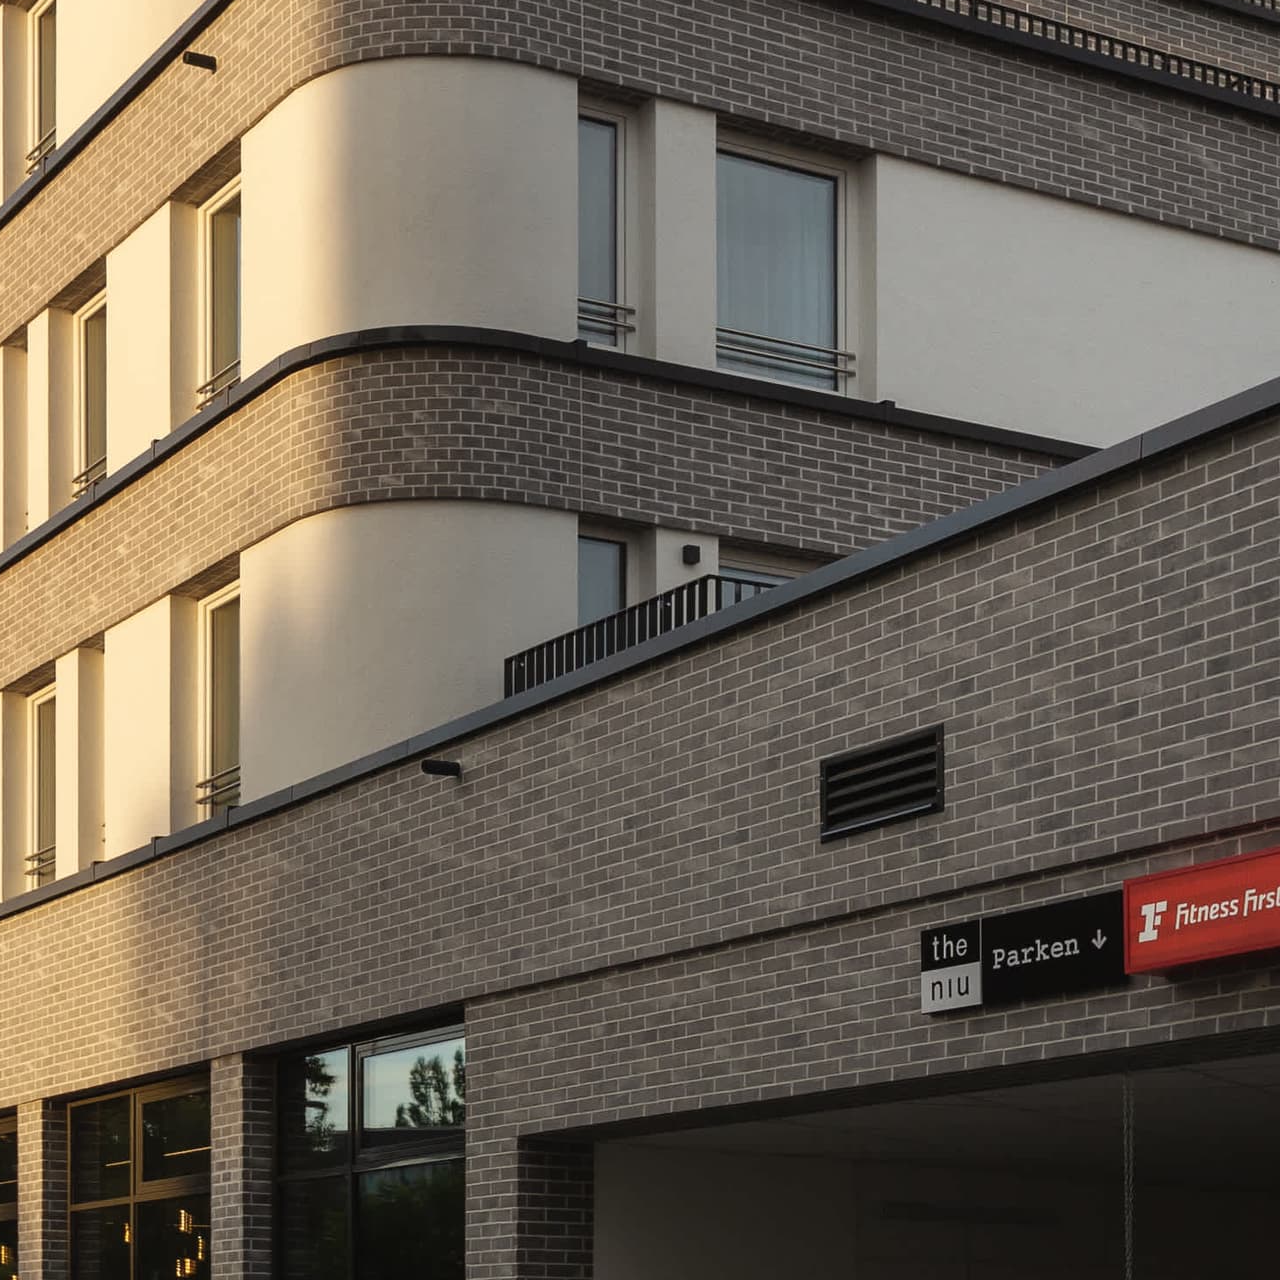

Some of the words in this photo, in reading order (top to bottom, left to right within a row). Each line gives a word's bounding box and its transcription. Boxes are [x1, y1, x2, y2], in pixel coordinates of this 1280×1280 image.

[932, 934, 968, 961] the
[992, 937, 1080, 969] Parken
[931, 975, 969, 1001] niu
